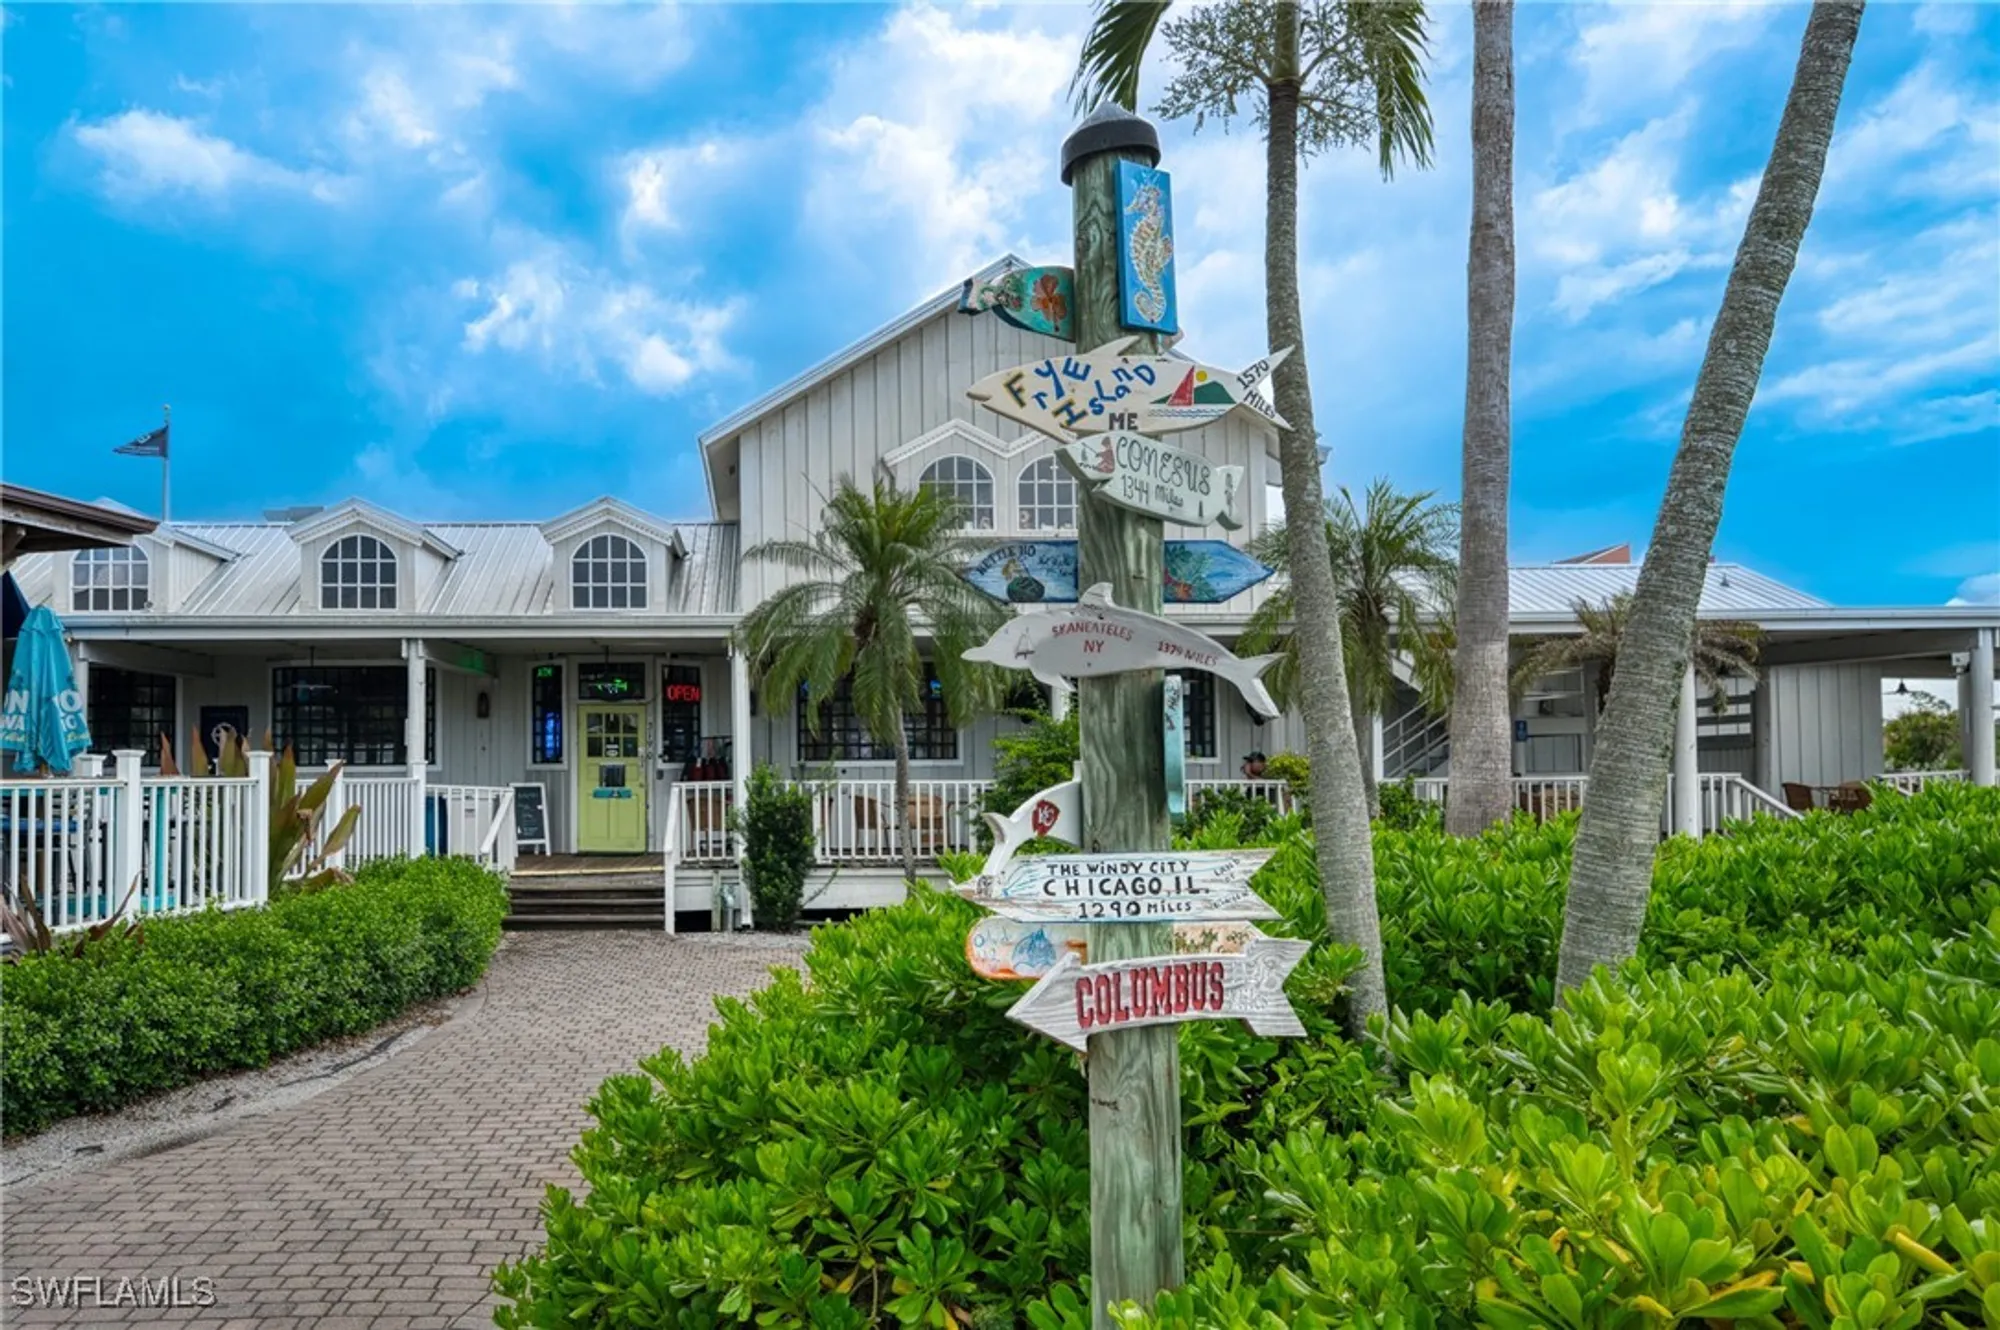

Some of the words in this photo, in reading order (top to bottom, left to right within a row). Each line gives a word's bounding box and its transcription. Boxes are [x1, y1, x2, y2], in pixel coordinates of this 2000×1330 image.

[1236, 360, 1269, 389] 1570
[1243, 390, 1275, 418] MILES
[1109, 412, 1138, 431] ME
[1121, 474, 1149, 505] 1344
[1083, 639, 1105, 653] NY
[667, 684, 700, 701] OPEN
[1046, 863, 1080, 876] THE
[1078, 900, 1141, 918] 1290
[1075, 961, 1225, 1029] COLUMBUS
